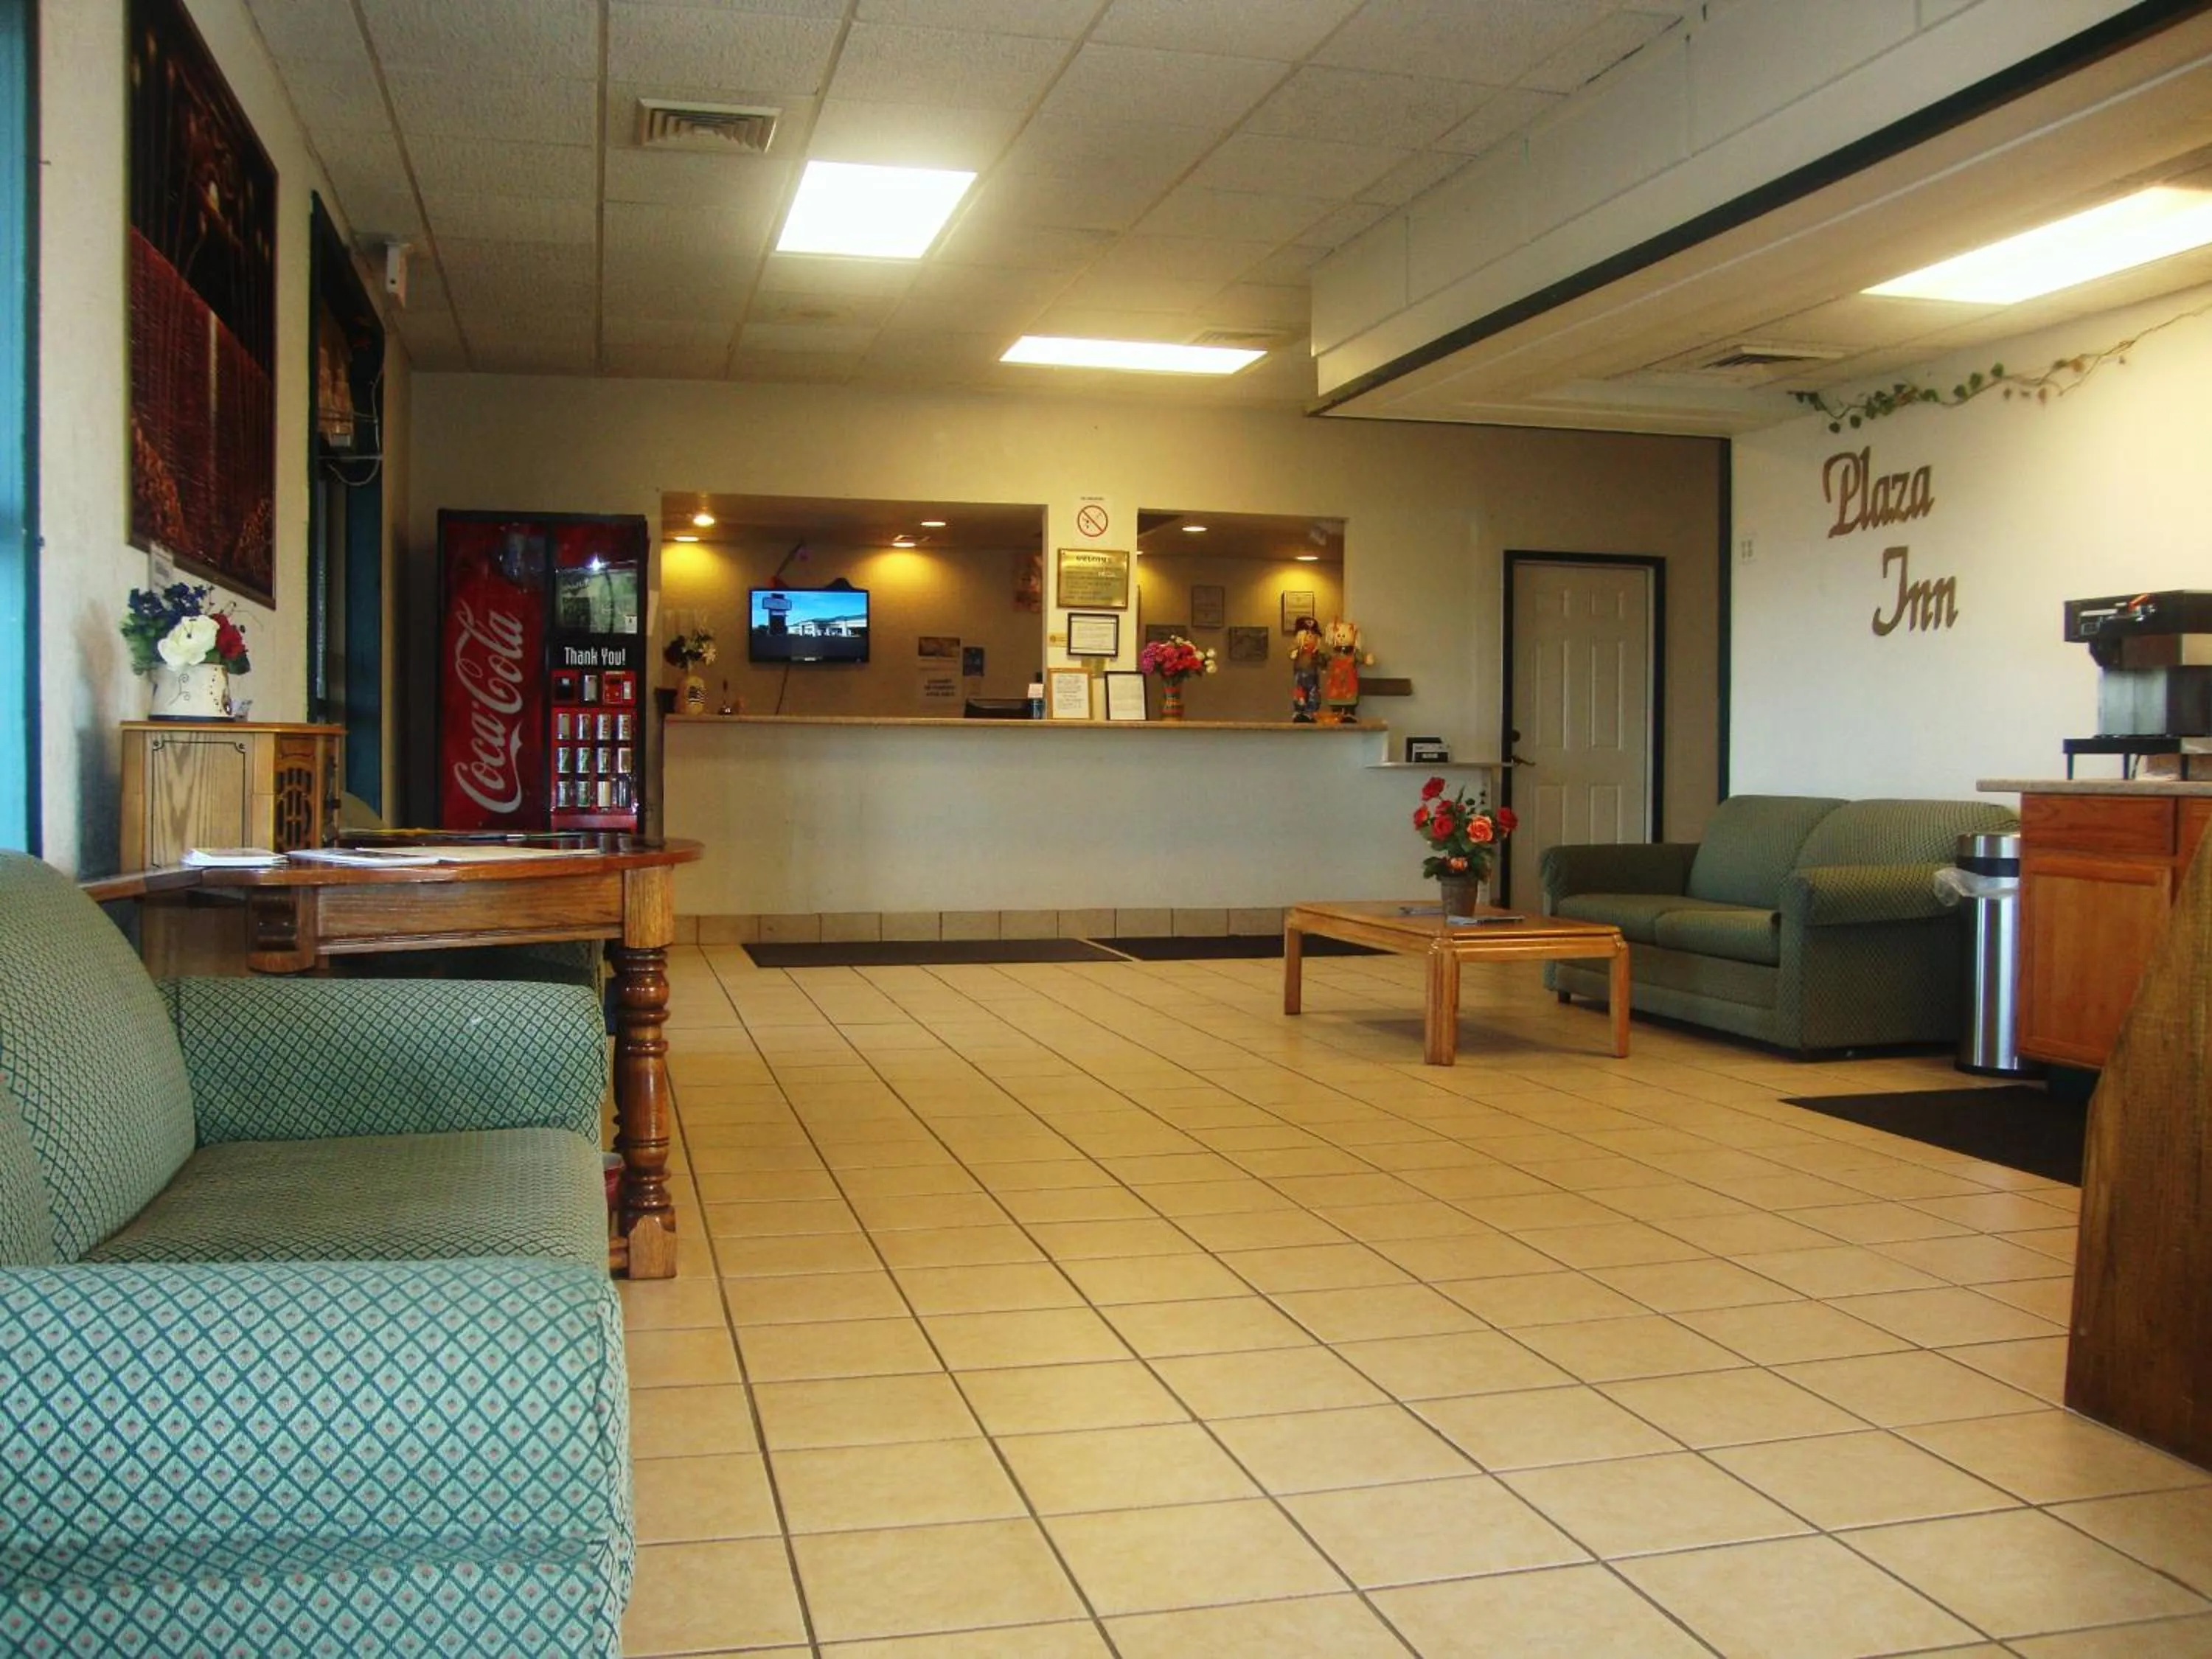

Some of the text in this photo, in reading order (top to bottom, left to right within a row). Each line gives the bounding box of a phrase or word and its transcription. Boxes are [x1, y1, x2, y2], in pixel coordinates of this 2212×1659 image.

[1822, 445, 1935, 538] Plaza
[1871, 546, 1958, 637] Inn
[564, 647, 626, 666] Thank You!
